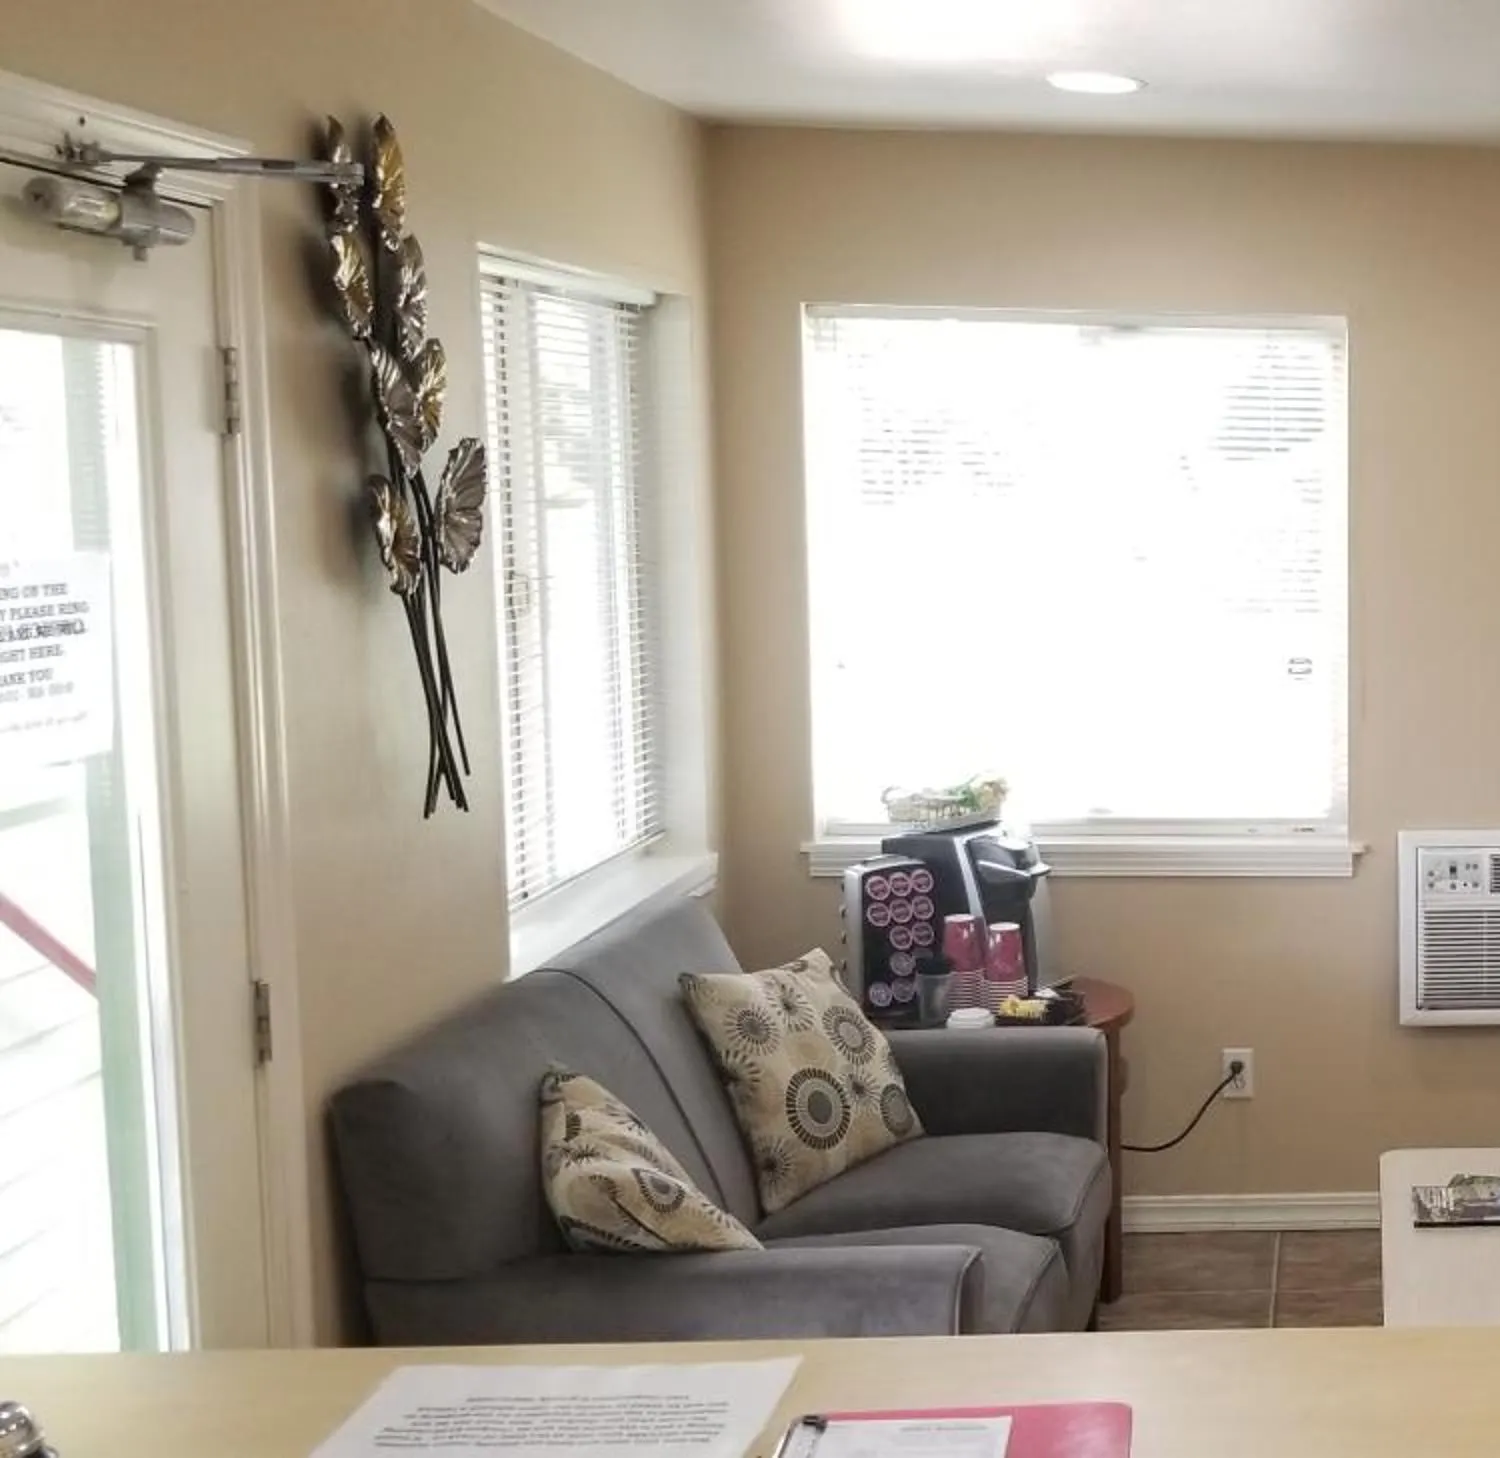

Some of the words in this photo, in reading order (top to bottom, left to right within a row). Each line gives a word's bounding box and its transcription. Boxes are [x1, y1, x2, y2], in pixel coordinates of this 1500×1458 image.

[42, 583, 68, 597] THE
[10, 604, 55, 621] PLEASE
[58, 600, 89, 615] RING
[28, 667, 53, 683] YOU
